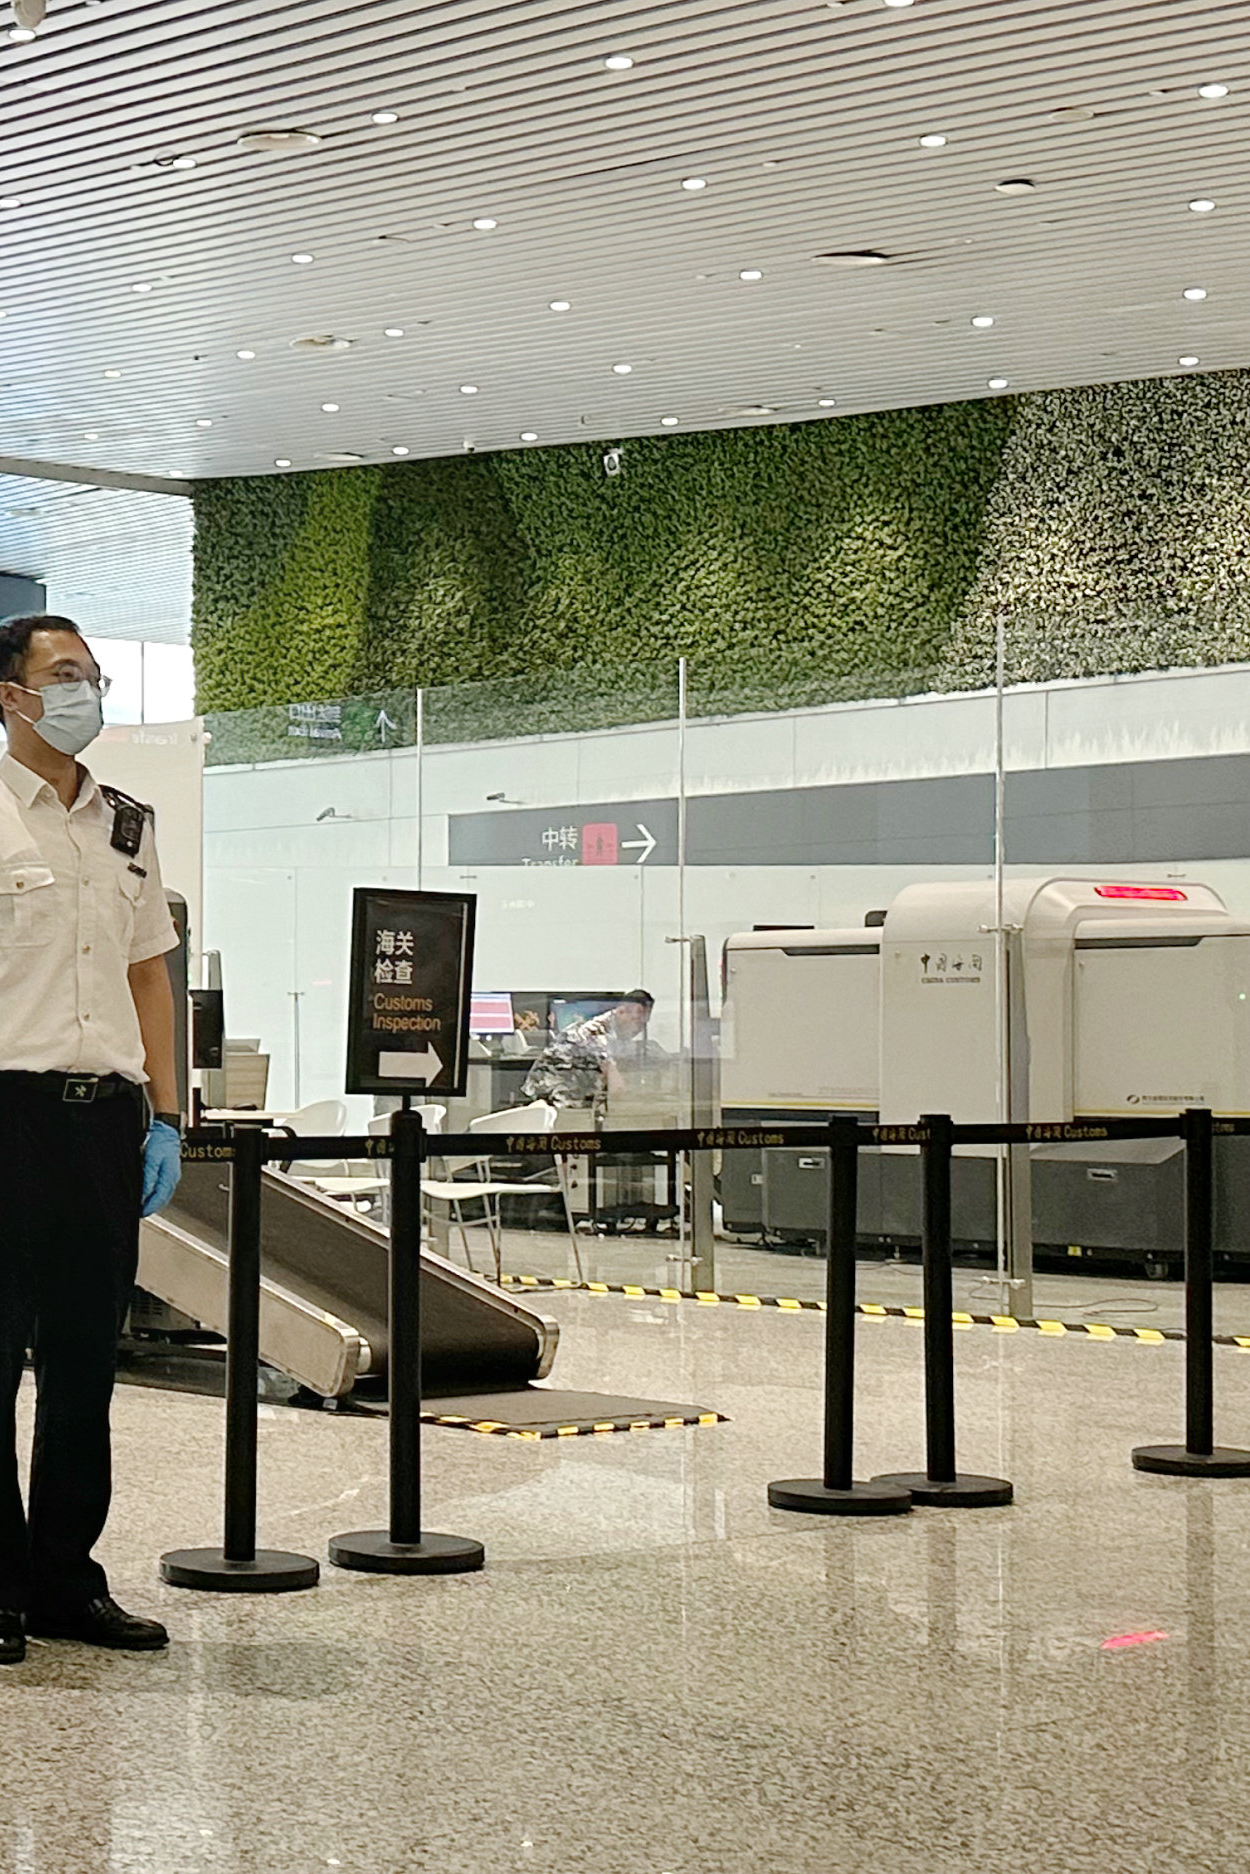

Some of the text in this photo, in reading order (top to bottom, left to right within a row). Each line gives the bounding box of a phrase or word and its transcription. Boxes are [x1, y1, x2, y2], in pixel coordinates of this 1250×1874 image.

[542, 825, 578, 852] 中转
[375, 929, 414, 956] 海关
[374, 958, 413, 985] 检查
[373, 992, 433, 1012] Customs
[372, 1013, 442, 1034] Inspection
[737, 1130, 785, 1145] Customs
[1064, 1124, 1108, 1138] Customs
[550, 1136, 602, 1151] Customs
